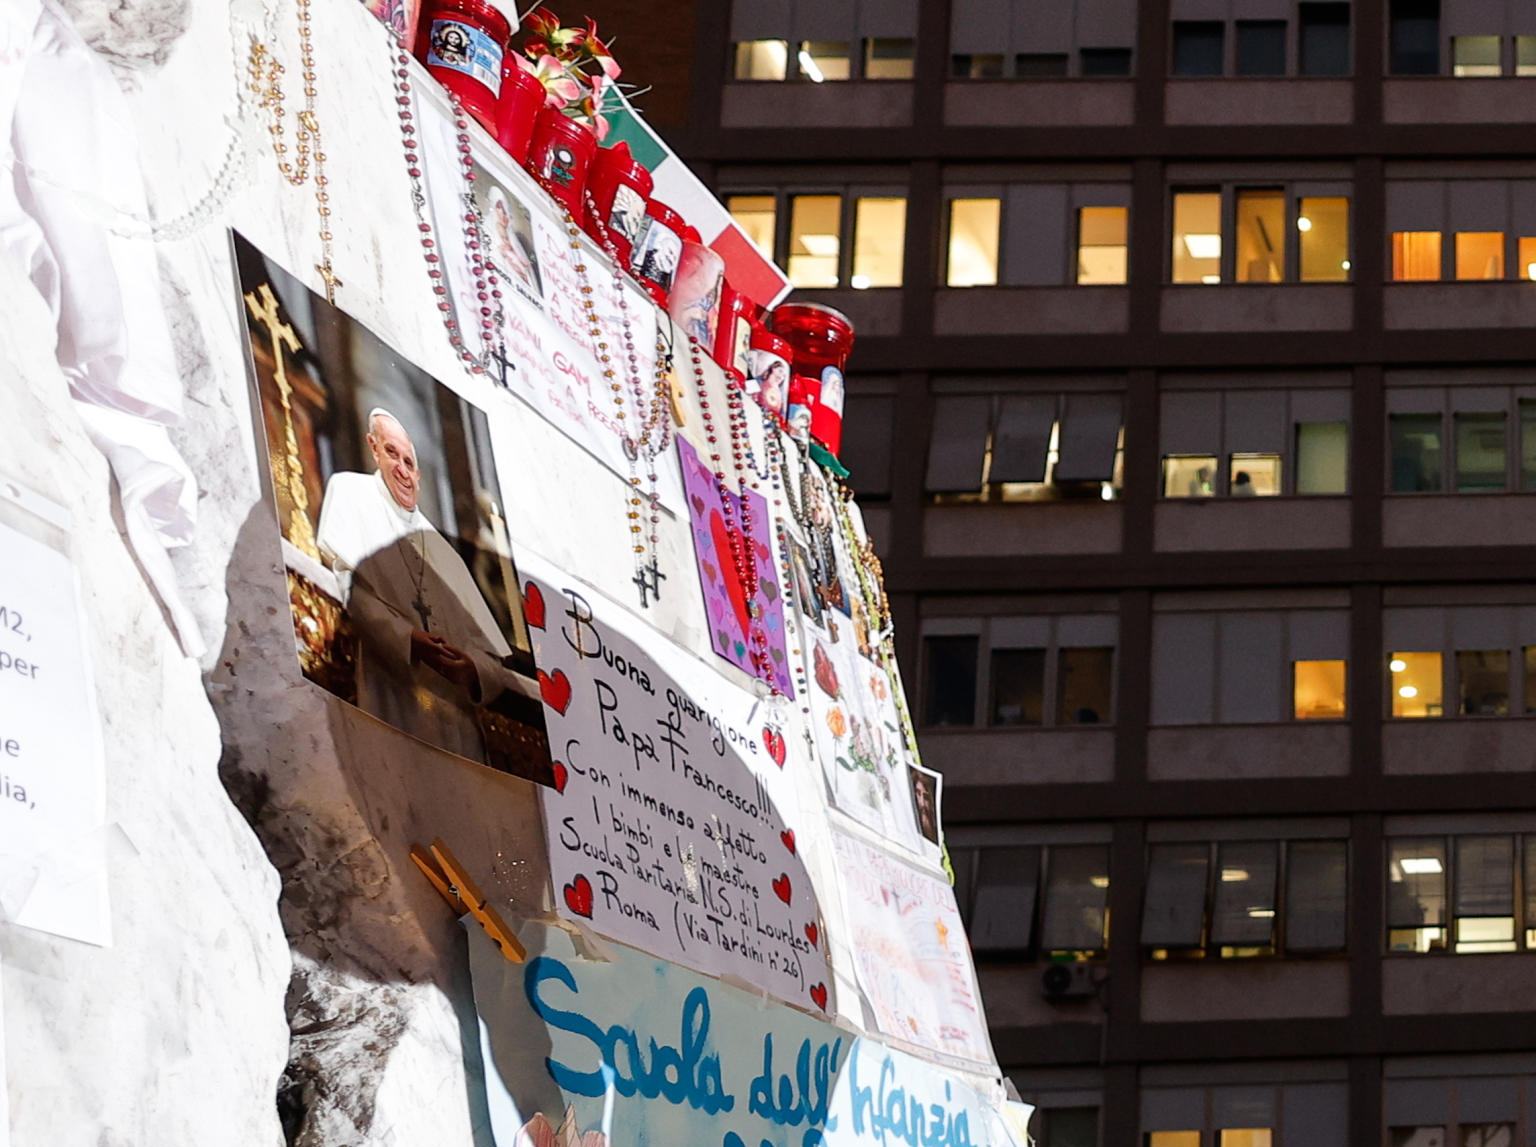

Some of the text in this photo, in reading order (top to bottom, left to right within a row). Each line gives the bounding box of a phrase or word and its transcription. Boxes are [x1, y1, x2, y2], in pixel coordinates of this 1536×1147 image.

[562, 588, 758, 757] Buona guarigione
[566, 739, 767, 865] Con immenso affetto
[656, 718, 776, 830] Francesco!!!
[559, 816, 628, 873] Scuola
[625, 842, 700, 906] Paritaria
[739, 903, 753, 928] di
[756, 901, 811, 955] Lourdes
[592, 795, 601, 825] I
[609, 802, 654, 849] bimbi
[663, 843, 672, 860] e
[700, 857, 760, 900] maestre
[596, 870, 661, 932] Roma
[674, 900, 711, 952] (Via
[707, 915, 765, 966] Tardini
[525, 956, 735, 1114] Scuola
